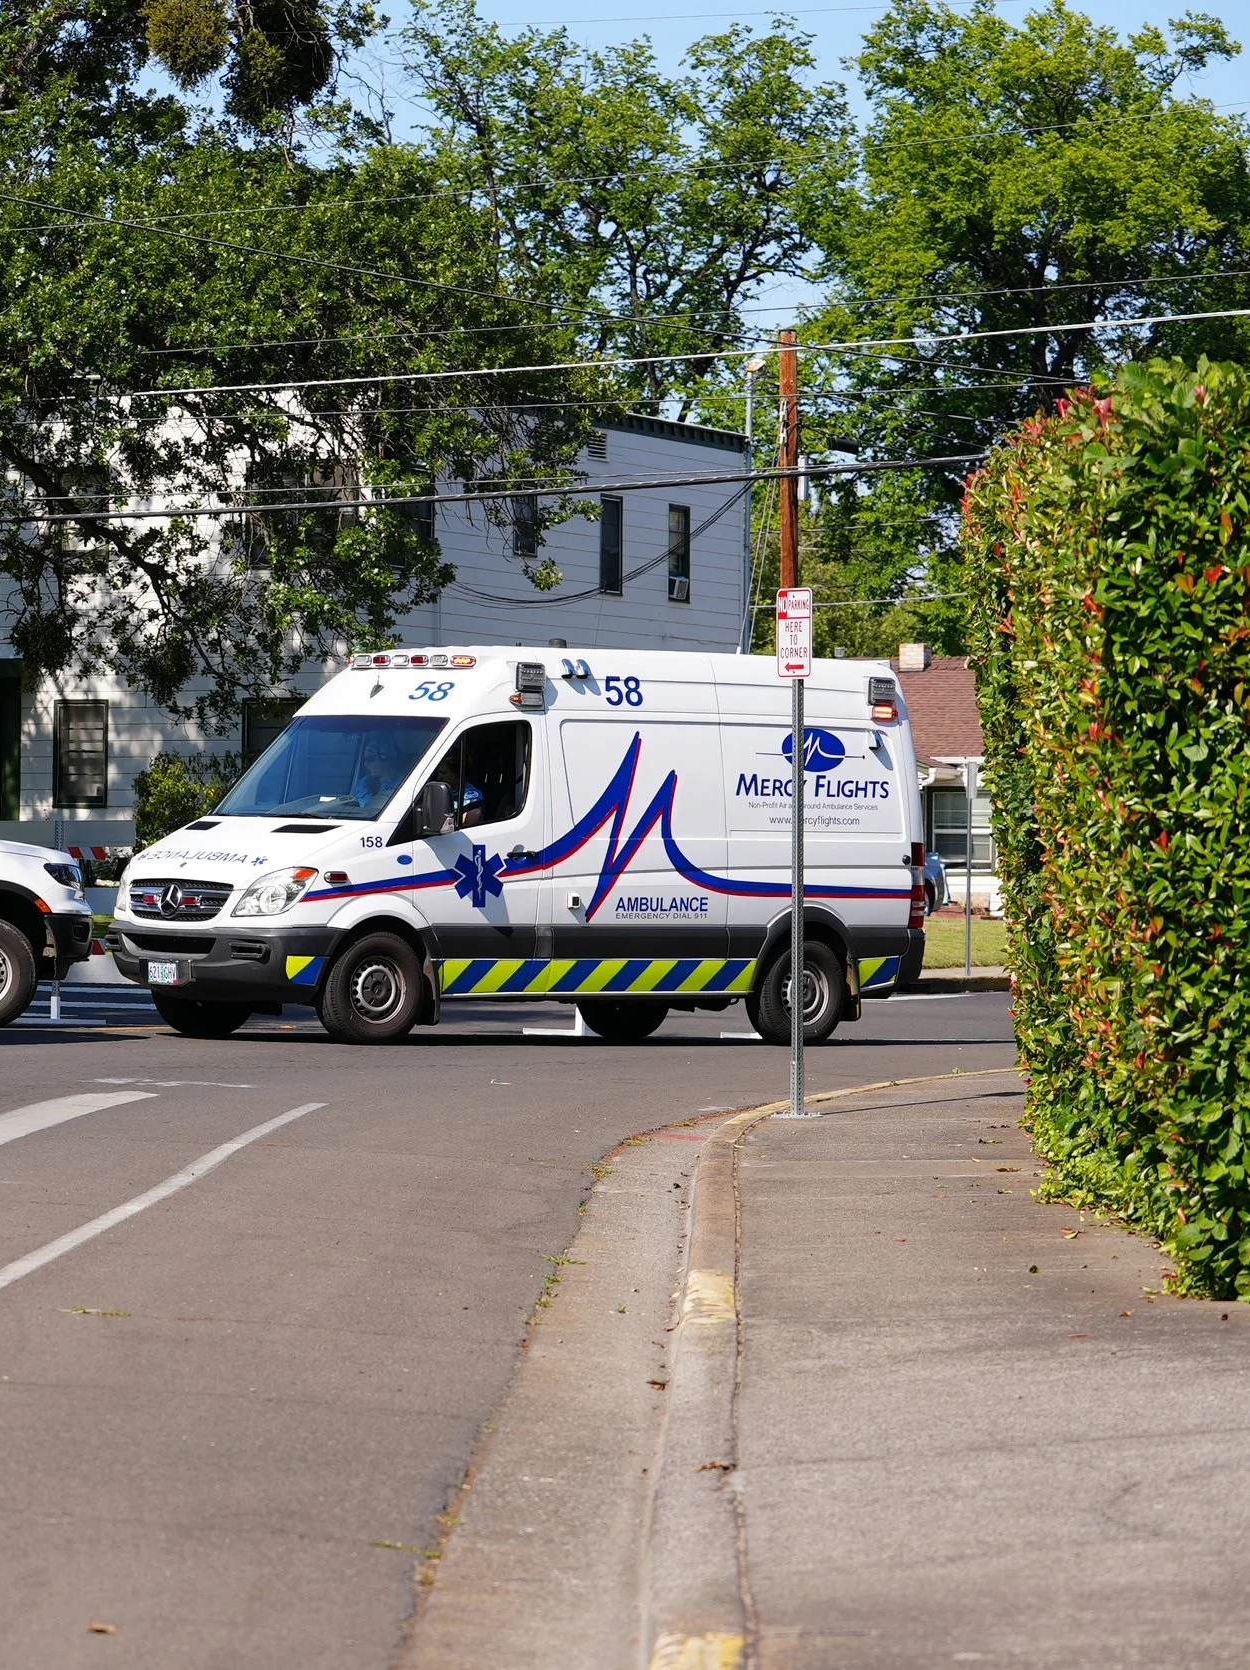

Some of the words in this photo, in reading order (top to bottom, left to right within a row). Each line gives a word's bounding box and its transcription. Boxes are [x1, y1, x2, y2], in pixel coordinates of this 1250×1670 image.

[778, 597, 788, 612] NO
[788, 599, 809, 610] PARKING
[785, 621, 803, 633] HERE
[789, 634, 798, 646] TO
[780, 647, 808, 659] CORNER
[408, 681, 455, 701] 58
[604, 675, 643, 707] 58
[736, 773, 807, 797] MERC
[814, 775, 890, 799] FLIGHTS
[748, 801, 778, 809] Non-Profit
[822, 802, 852, 810] Ambulance
[854, 803, 878, 811] Services
[360, 836, 383, 848] 158
[615, 897, 709, 912] AMBULANCE
